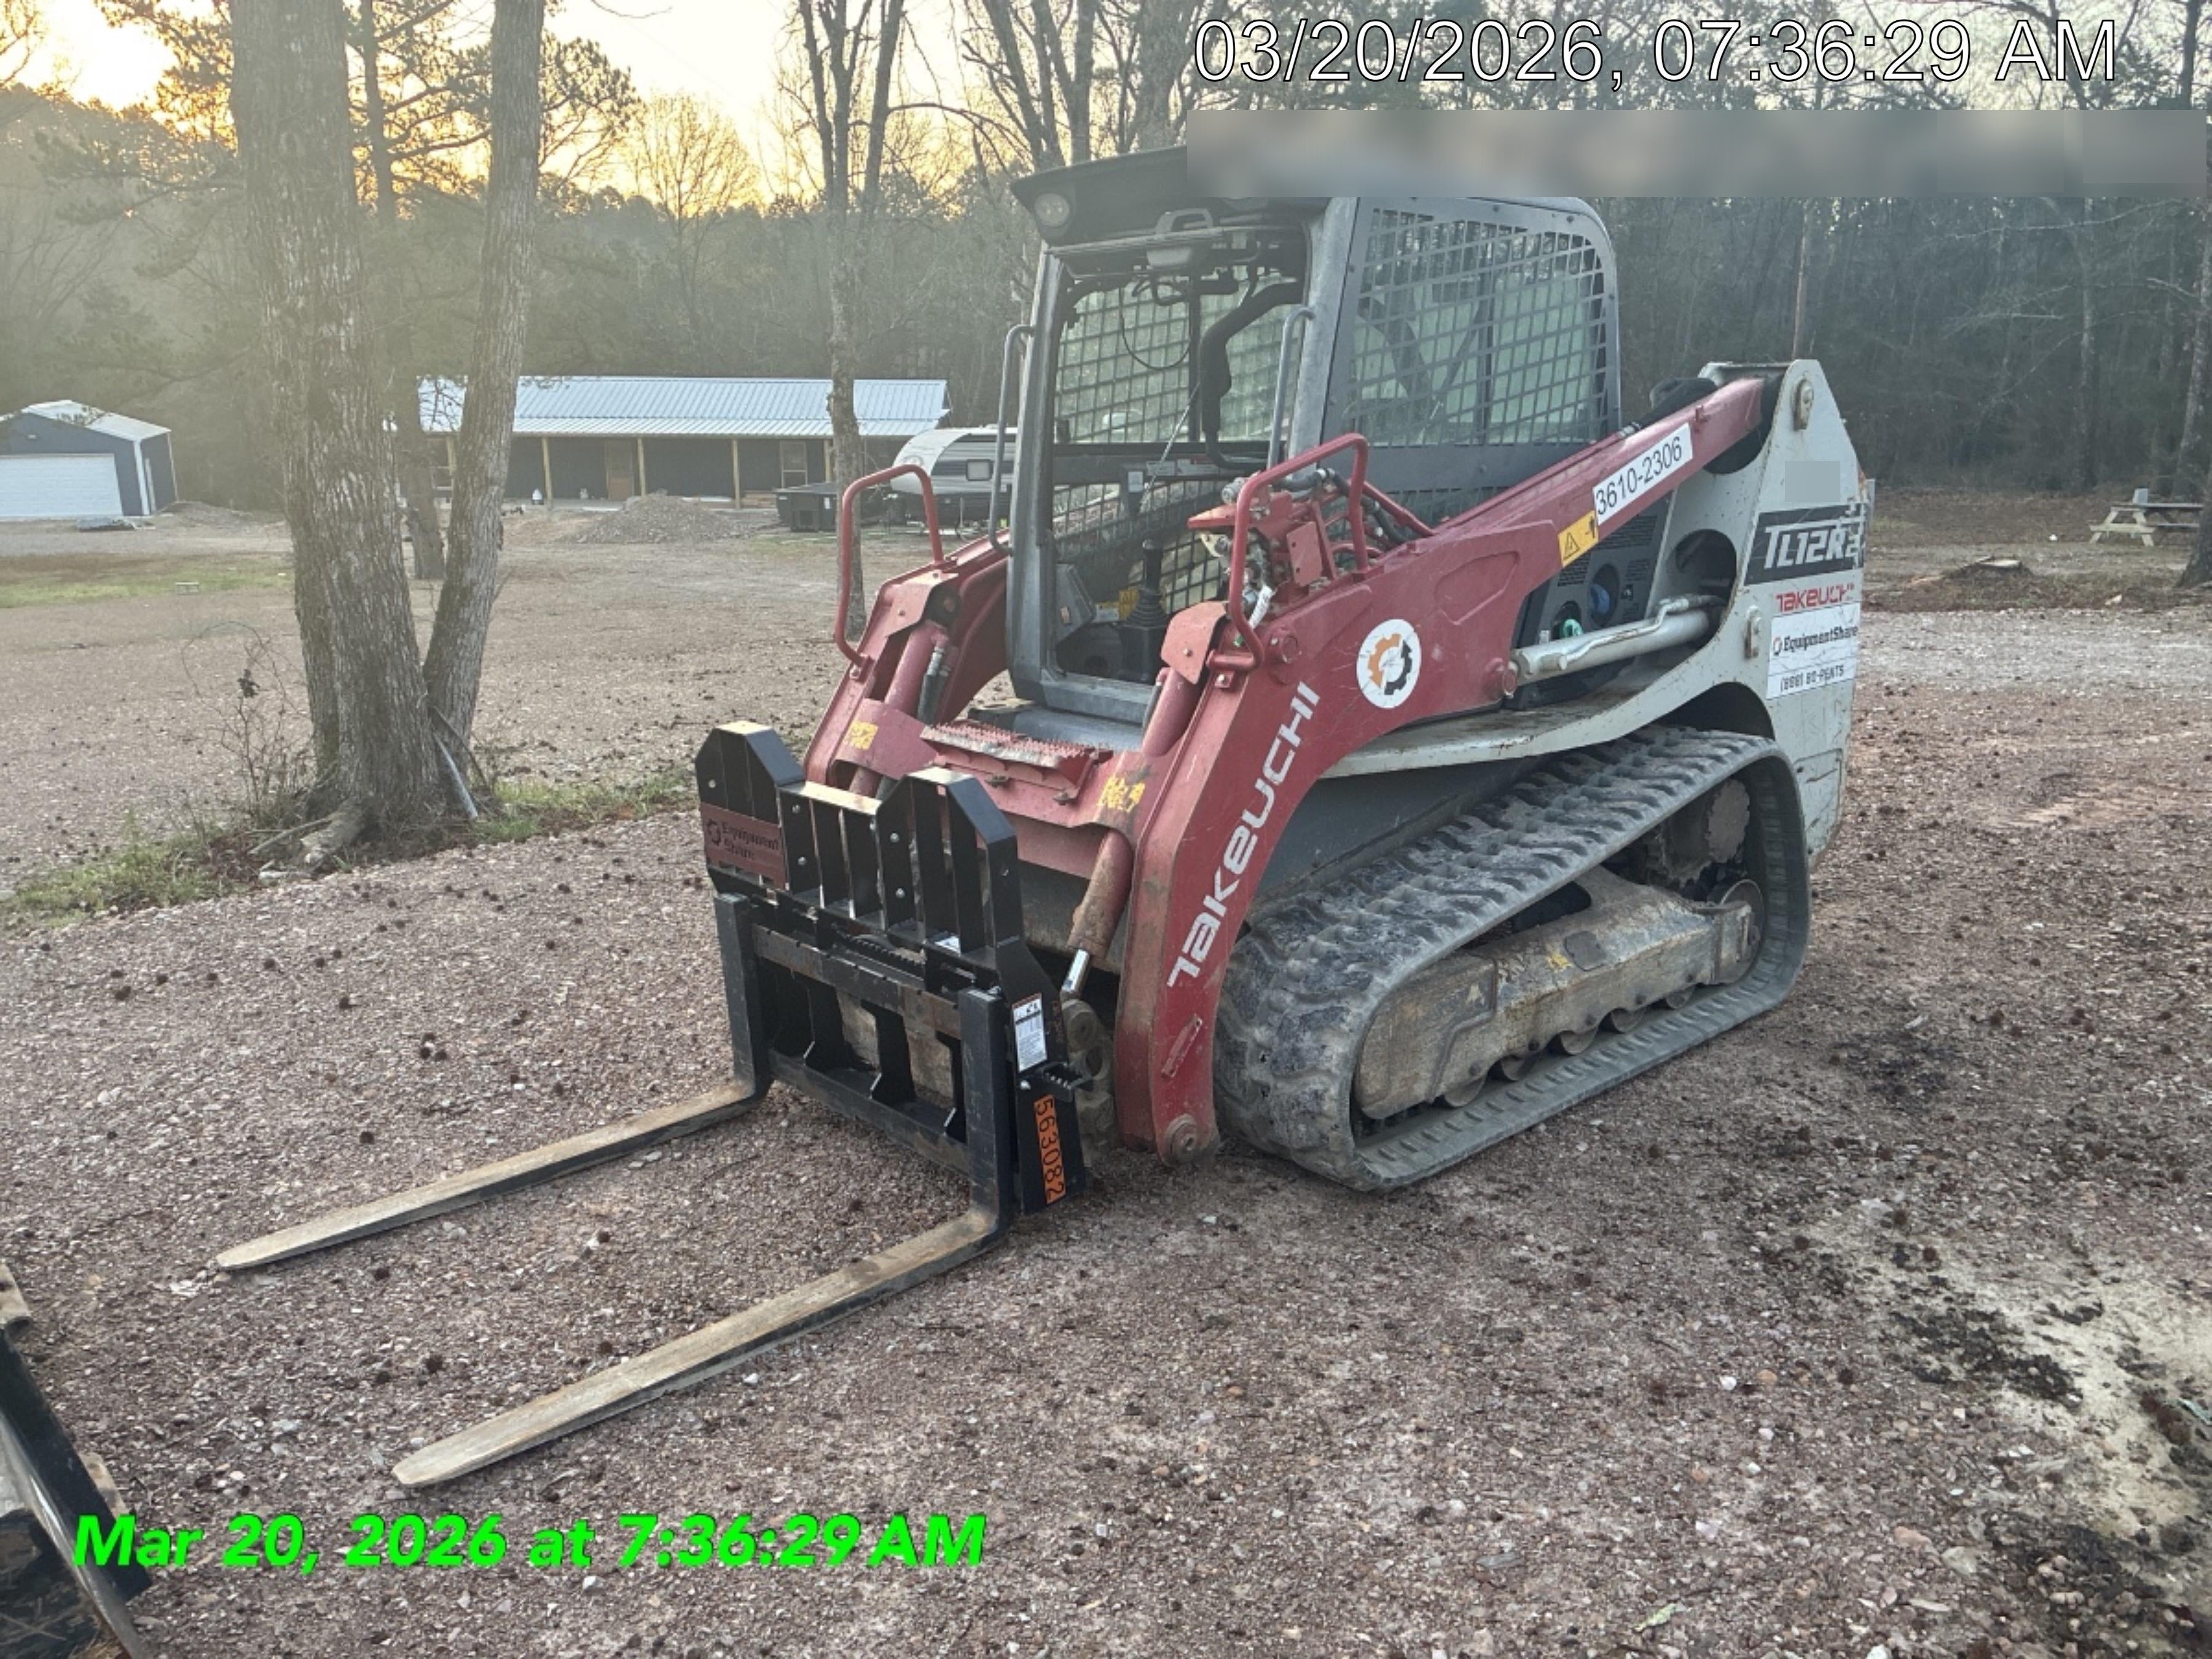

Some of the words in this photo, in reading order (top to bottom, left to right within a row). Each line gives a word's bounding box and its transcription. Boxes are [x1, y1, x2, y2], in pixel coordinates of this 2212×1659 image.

[1596, 436, 1682, 515] 3610-2306
[1784, 626, 1859, 653] EquipmentShare
[1037, 1098, 1064, 1200] 563082
